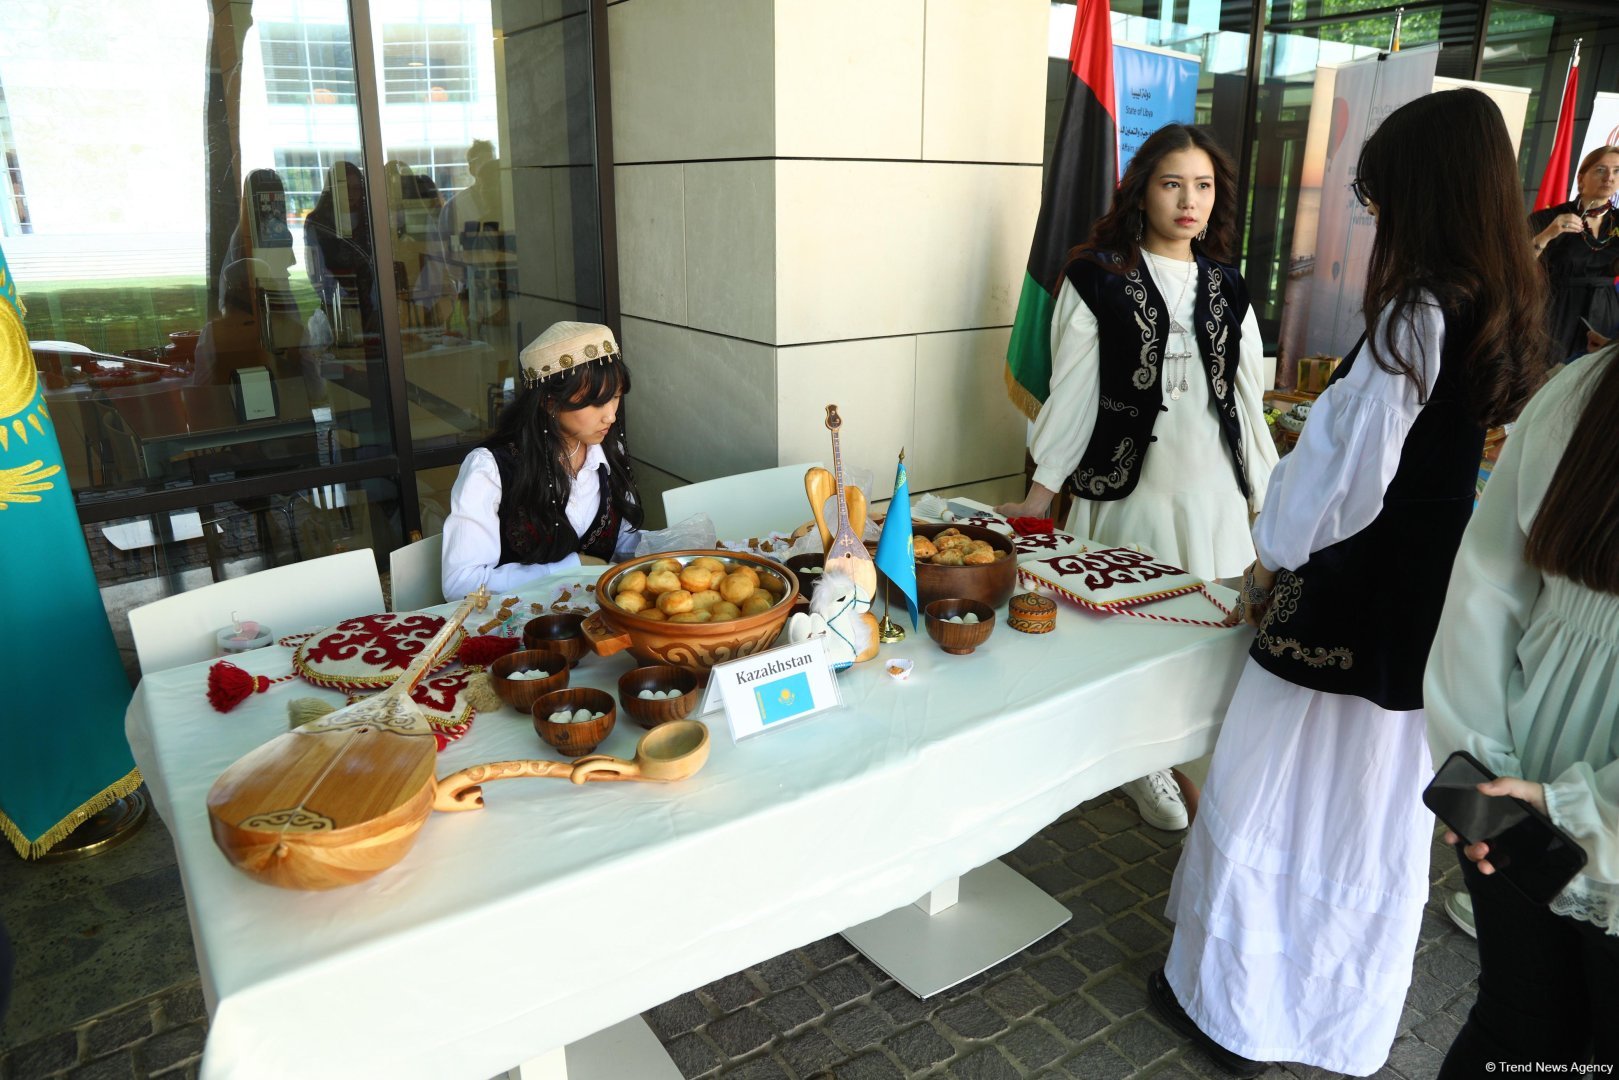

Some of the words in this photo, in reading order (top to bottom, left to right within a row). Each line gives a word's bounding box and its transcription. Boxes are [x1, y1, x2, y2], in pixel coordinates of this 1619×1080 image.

[1125, 105, 1137, 115] State
[1143, 108, 1154, 118] Libya
[735, 653, 813, 685] Kazakhstan
